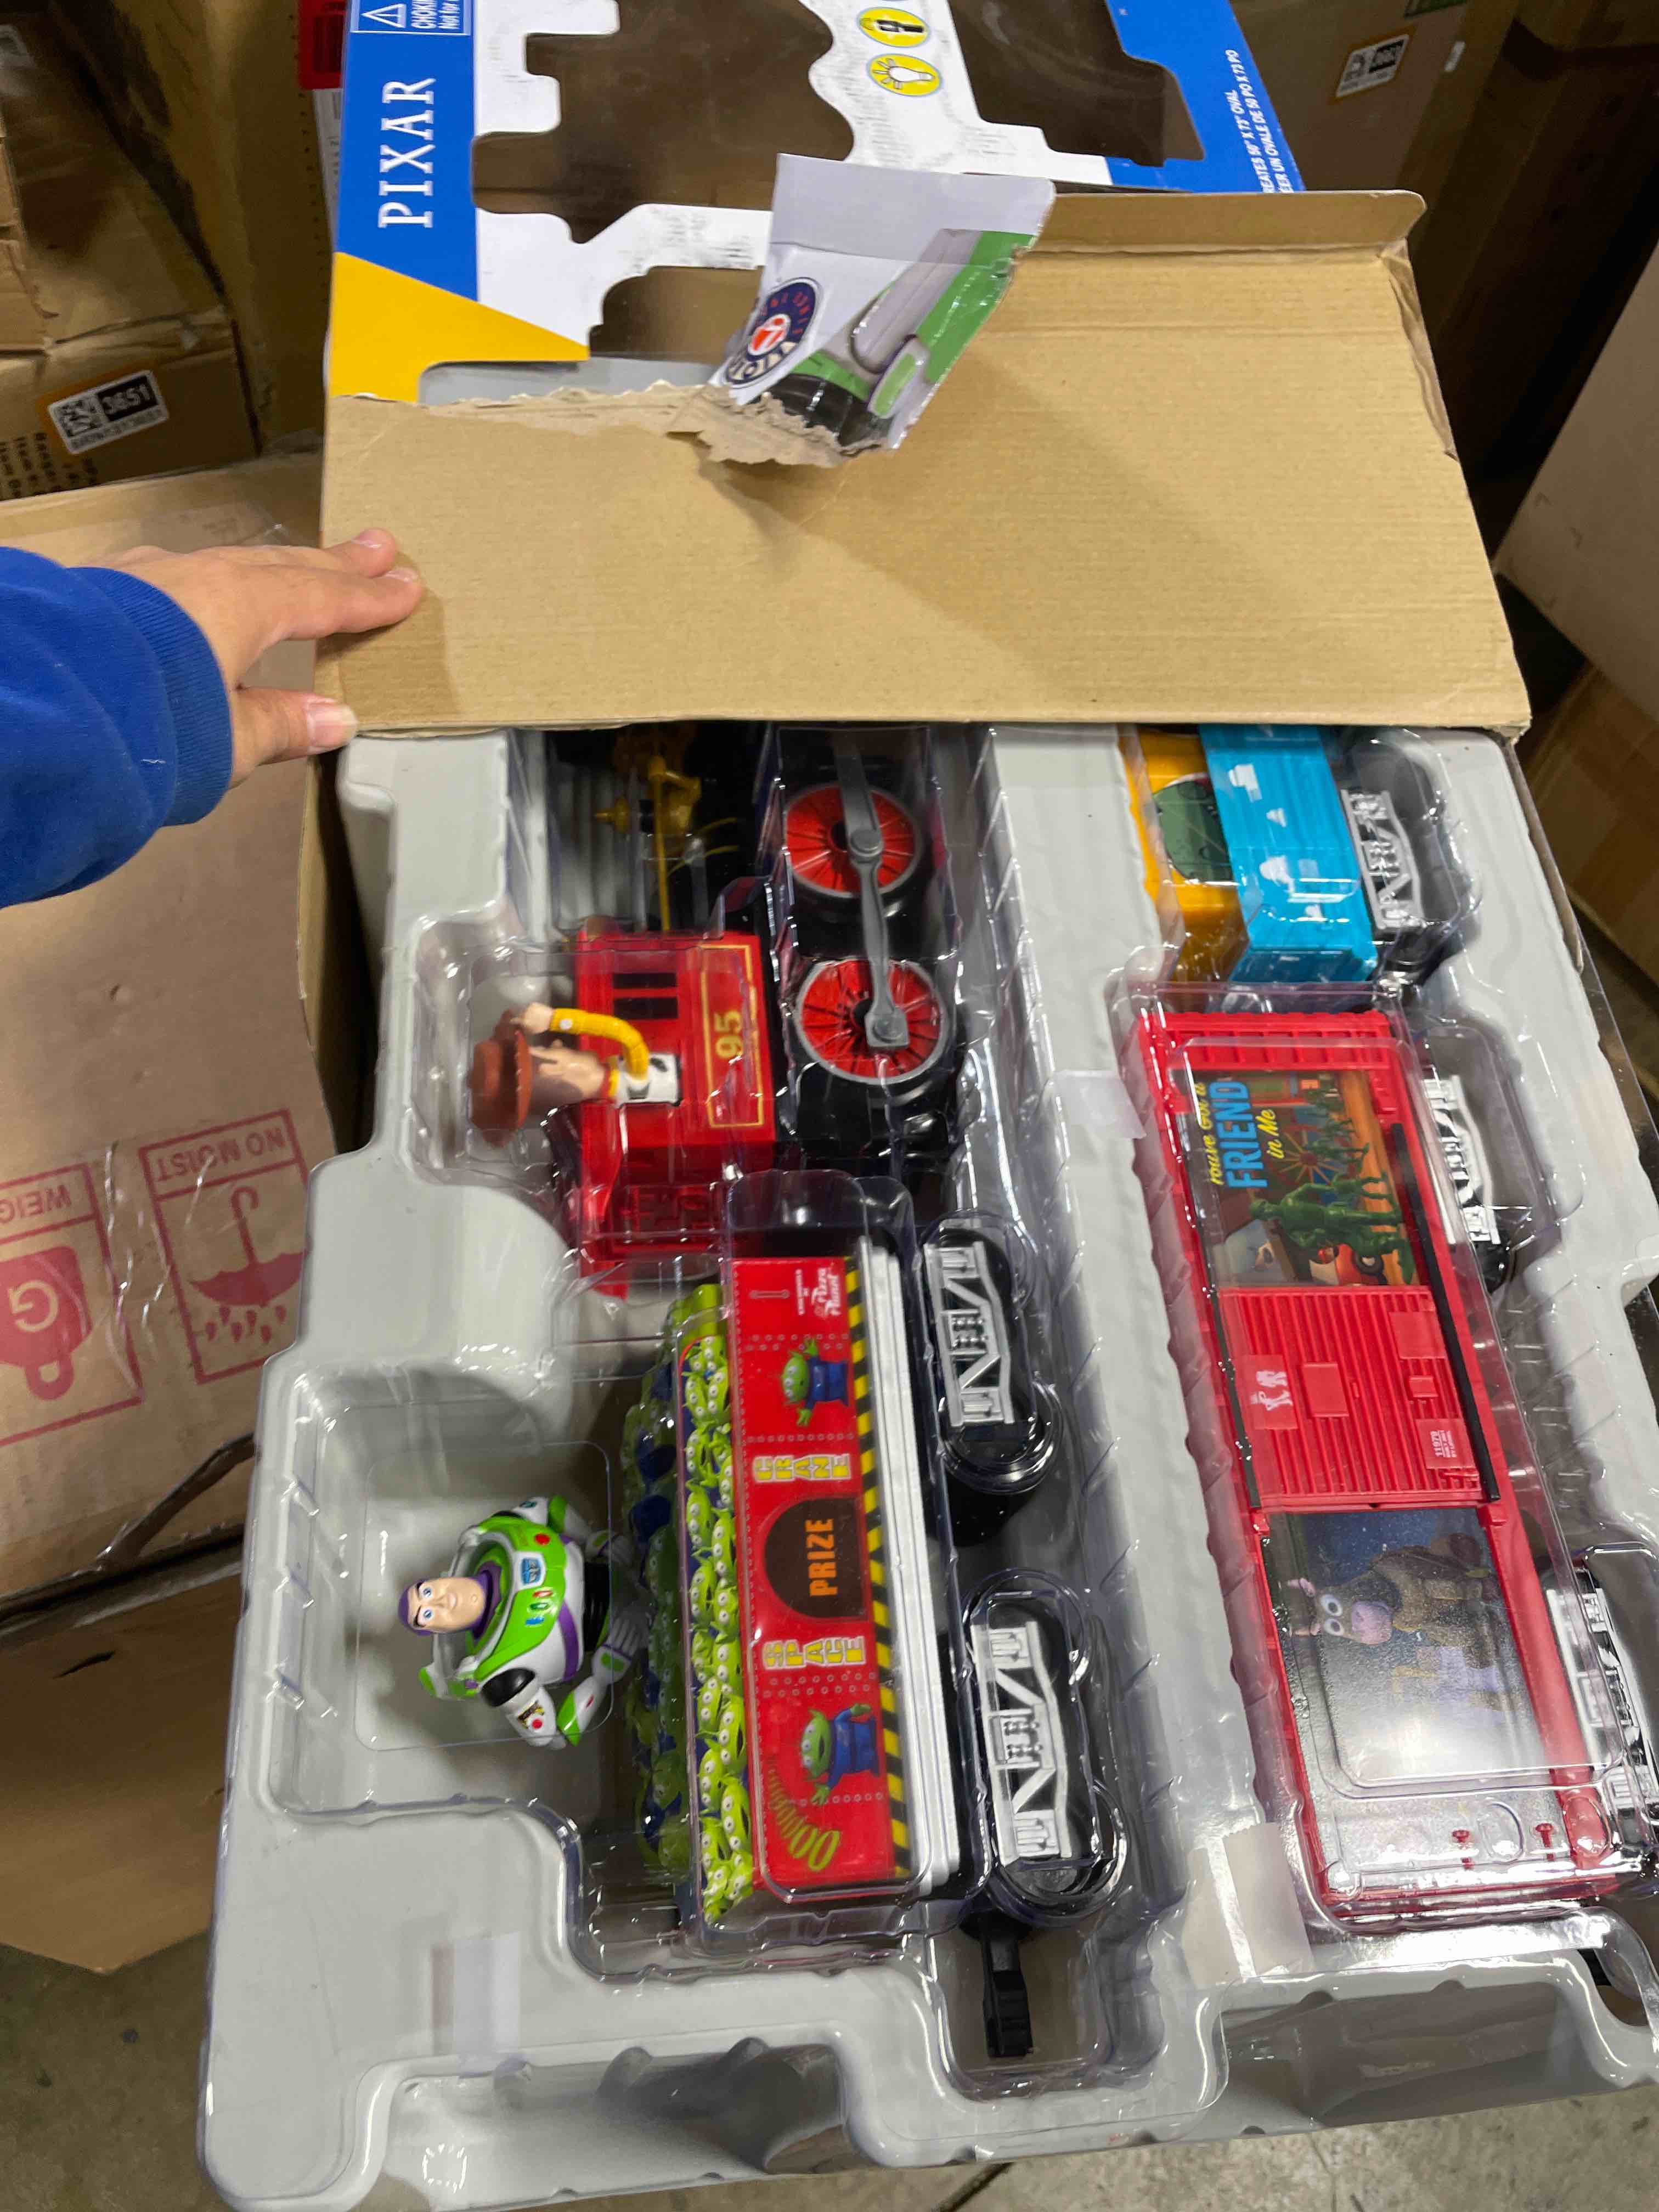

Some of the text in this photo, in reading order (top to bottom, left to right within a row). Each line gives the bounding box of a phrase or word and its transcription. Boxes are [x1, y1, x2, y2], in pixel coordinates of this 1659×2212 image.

[438, 15, 460, 30] Not
[1224, 89, 1245, 115] OVAL
[377, 78, 436, 228] PIXAR
[1255, 124, 1279, 156] OVALE
[1268, 157, 1285, 172] UN
[714, 1011, 743, 1059] 95
[156, 1127, 286, 1182] NO MOIST
[1209, 1081, 1268, 1188] FRIEND
[1255, 1109, 1285, 1159] in Me
[753, 1454, 851, 1482] CRANE
[805, 1518, 838, 1597] PRIZE
[763, 1635, 866, 1670] SPACE
